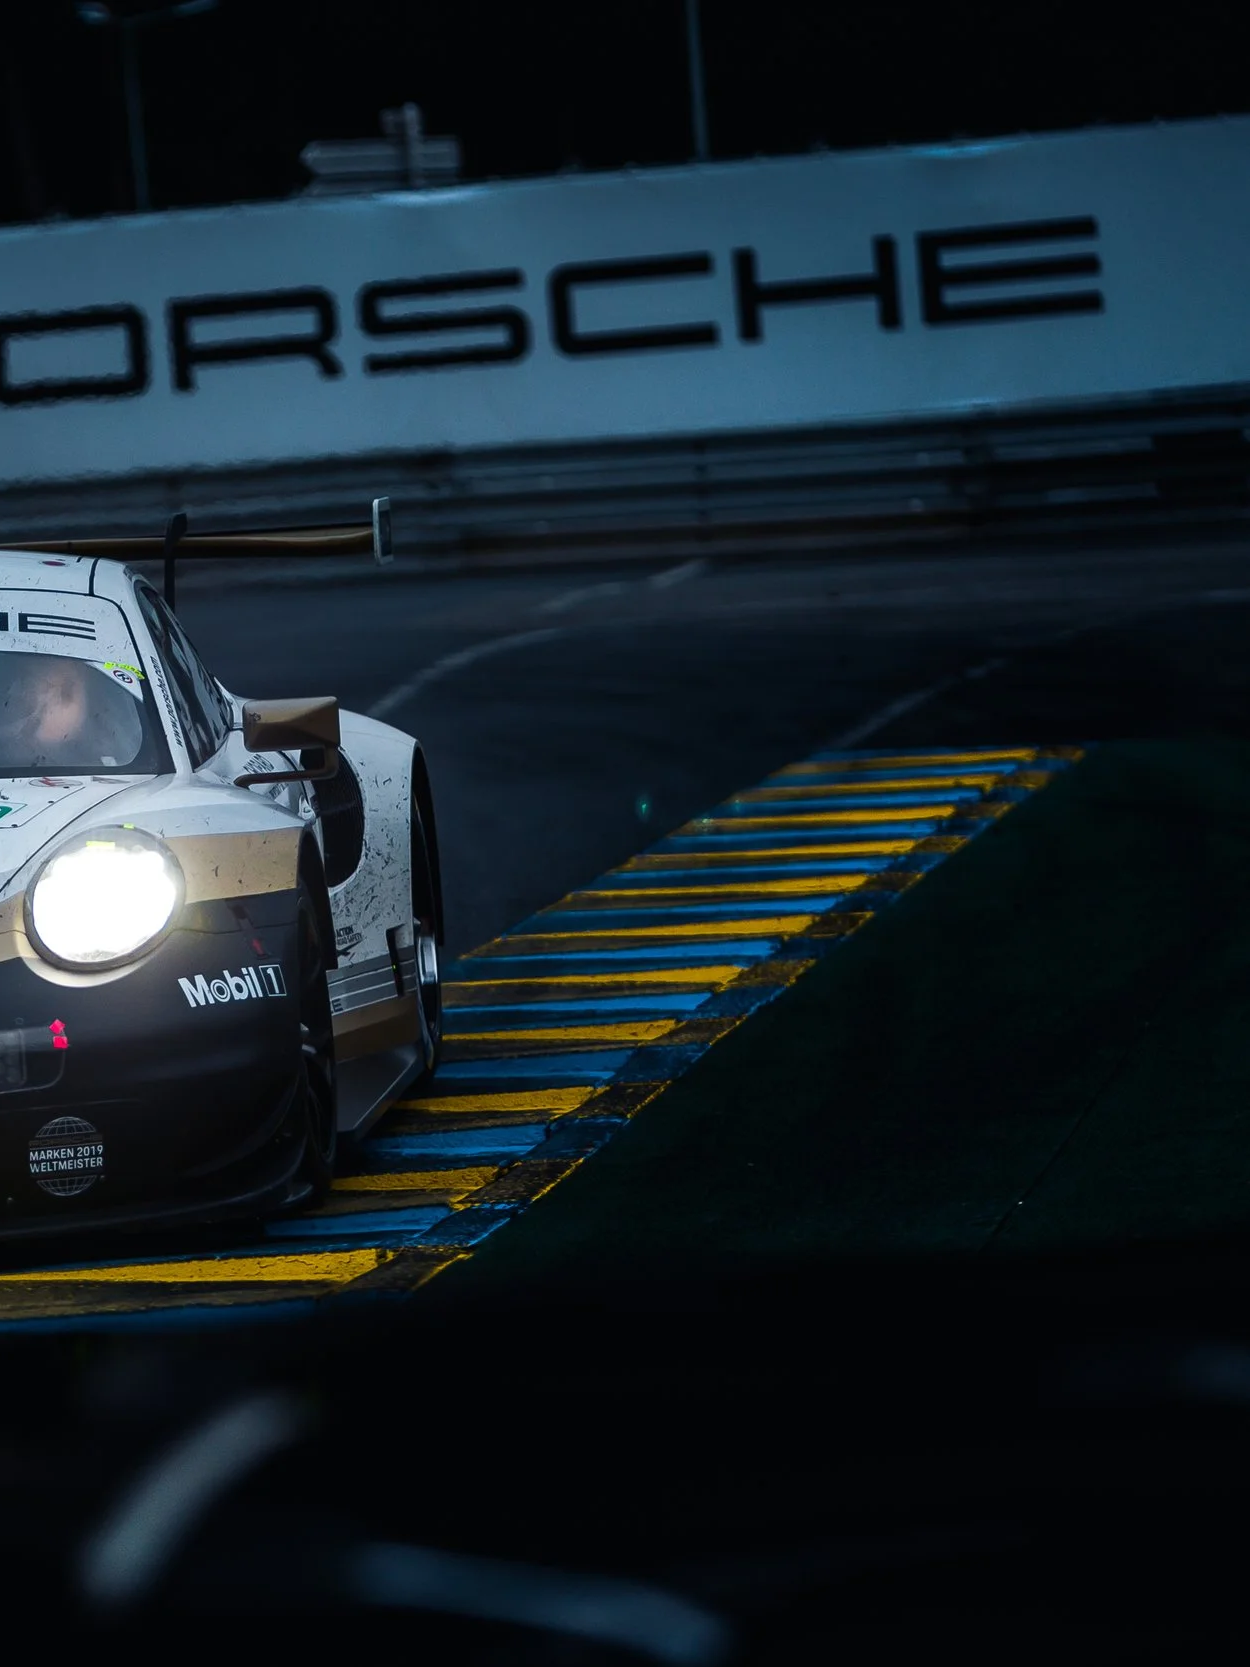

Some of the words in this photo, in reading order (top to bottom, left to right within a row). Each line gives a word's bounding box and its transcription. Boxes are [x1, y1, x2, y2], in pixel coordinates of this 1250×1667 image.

[177, 966, 263, 1008] Mobil
[265, 966, 281, 995] 1
[30, 1148, 74, 1161] MARKEN
[77, 1145, 103, 1157] 2019
[29, 1157, 103, 1173] WELTMEISTER
